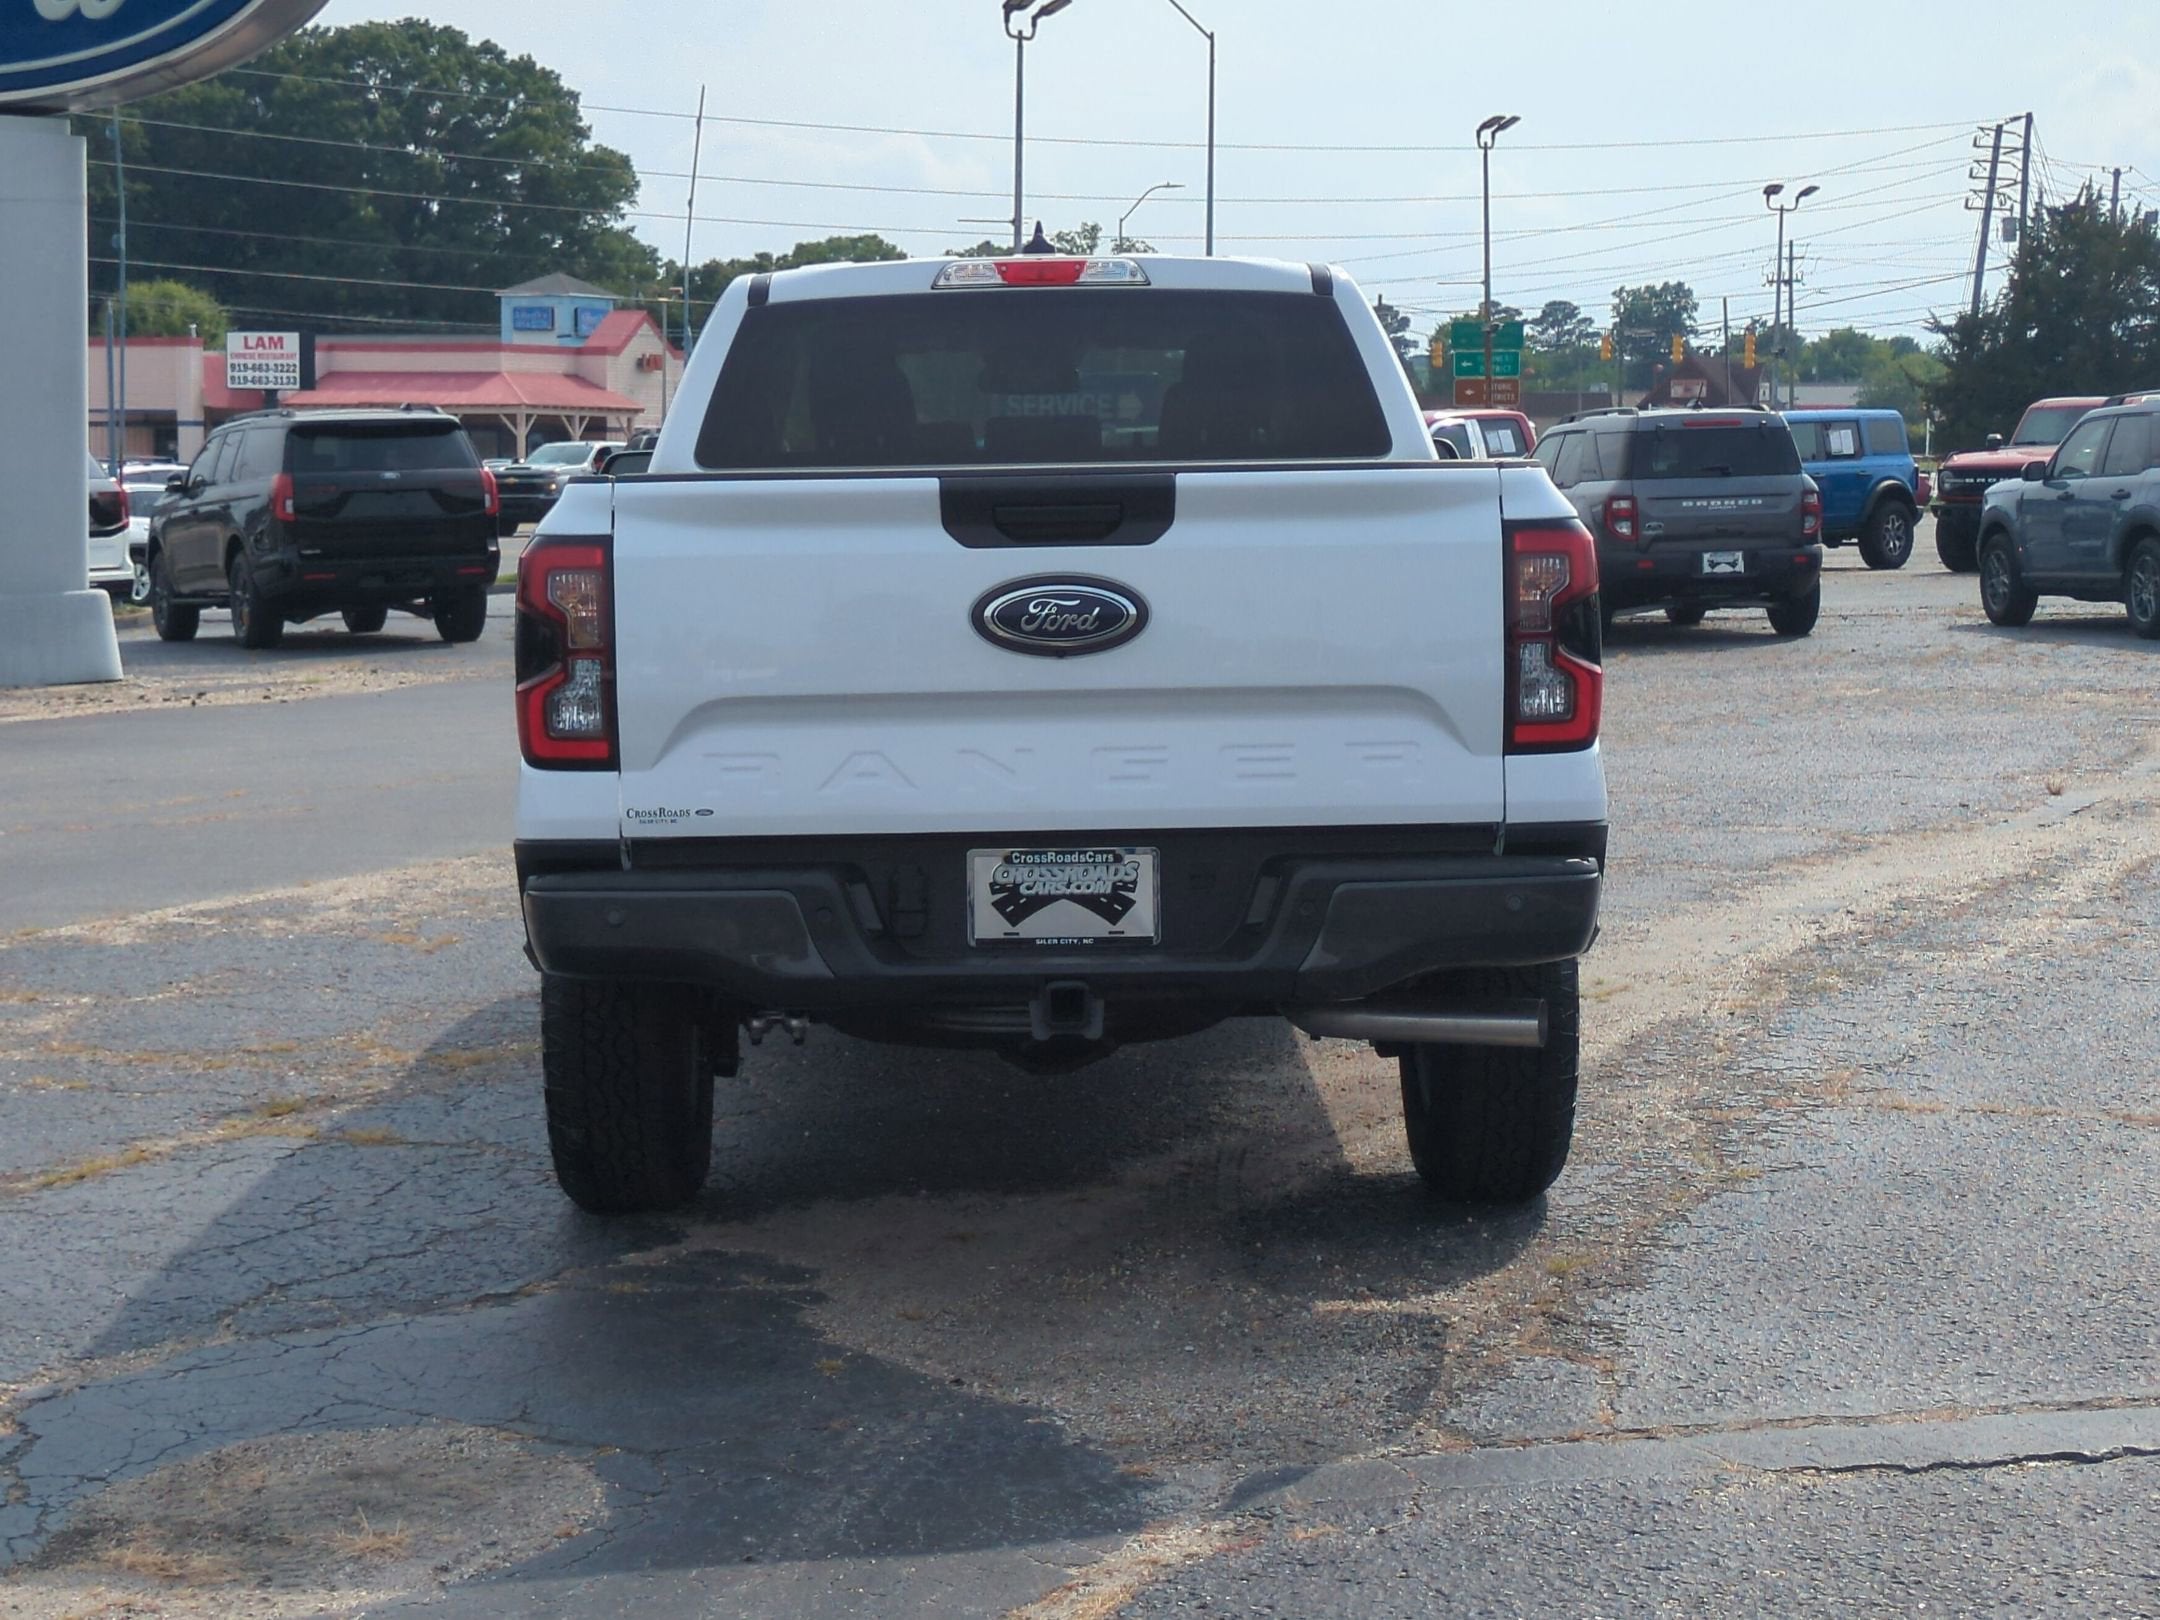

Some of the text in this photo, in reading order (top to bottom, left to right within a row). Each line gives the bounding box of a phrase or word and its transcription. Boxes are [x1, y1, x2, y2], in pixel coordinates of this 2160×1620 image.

[243, 335, 284, 350] LAM
[1007, 394, 1113, 418] SERVICE
[1020, 598, 1100, 631] Ford
[1011, 852, 1114, 864] CrossRoadsCars
[992, 861, 1140, 885] CROSSROADS
[1019, 880, 1113, 896] CARS.COM
